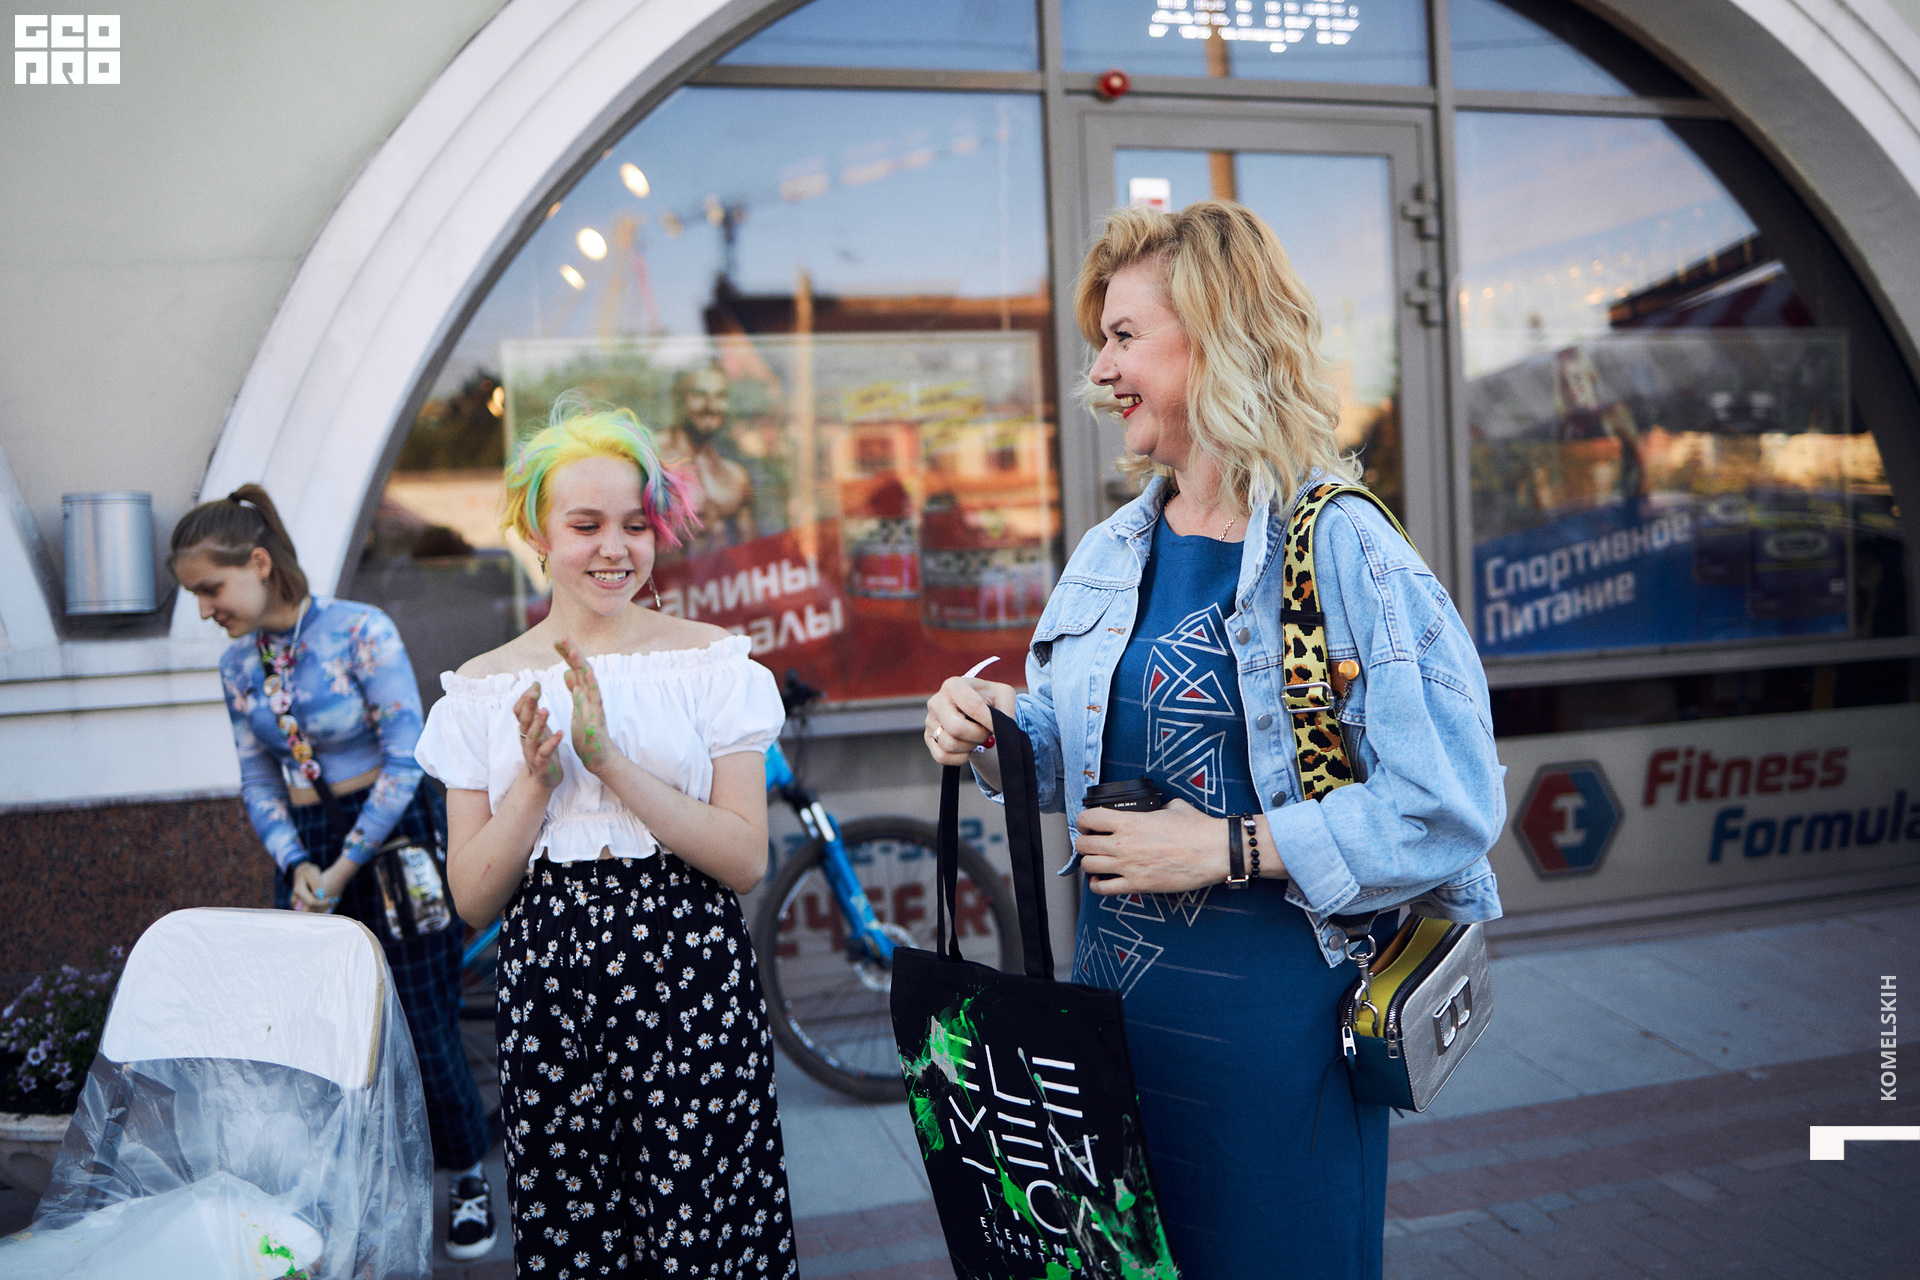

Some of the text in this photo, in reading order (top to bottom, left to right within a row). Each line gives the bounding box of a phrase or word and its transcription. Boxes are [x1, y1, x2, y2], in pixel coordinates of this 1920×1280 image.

[1484, 511, 1693, 599] Спортивное
[634, 556, 819, 621] амины
[1483, 570, 1637, 646] Питание
[726, 597, 843, 656] алы
[1642, 747, 1849, 807] Fitness
